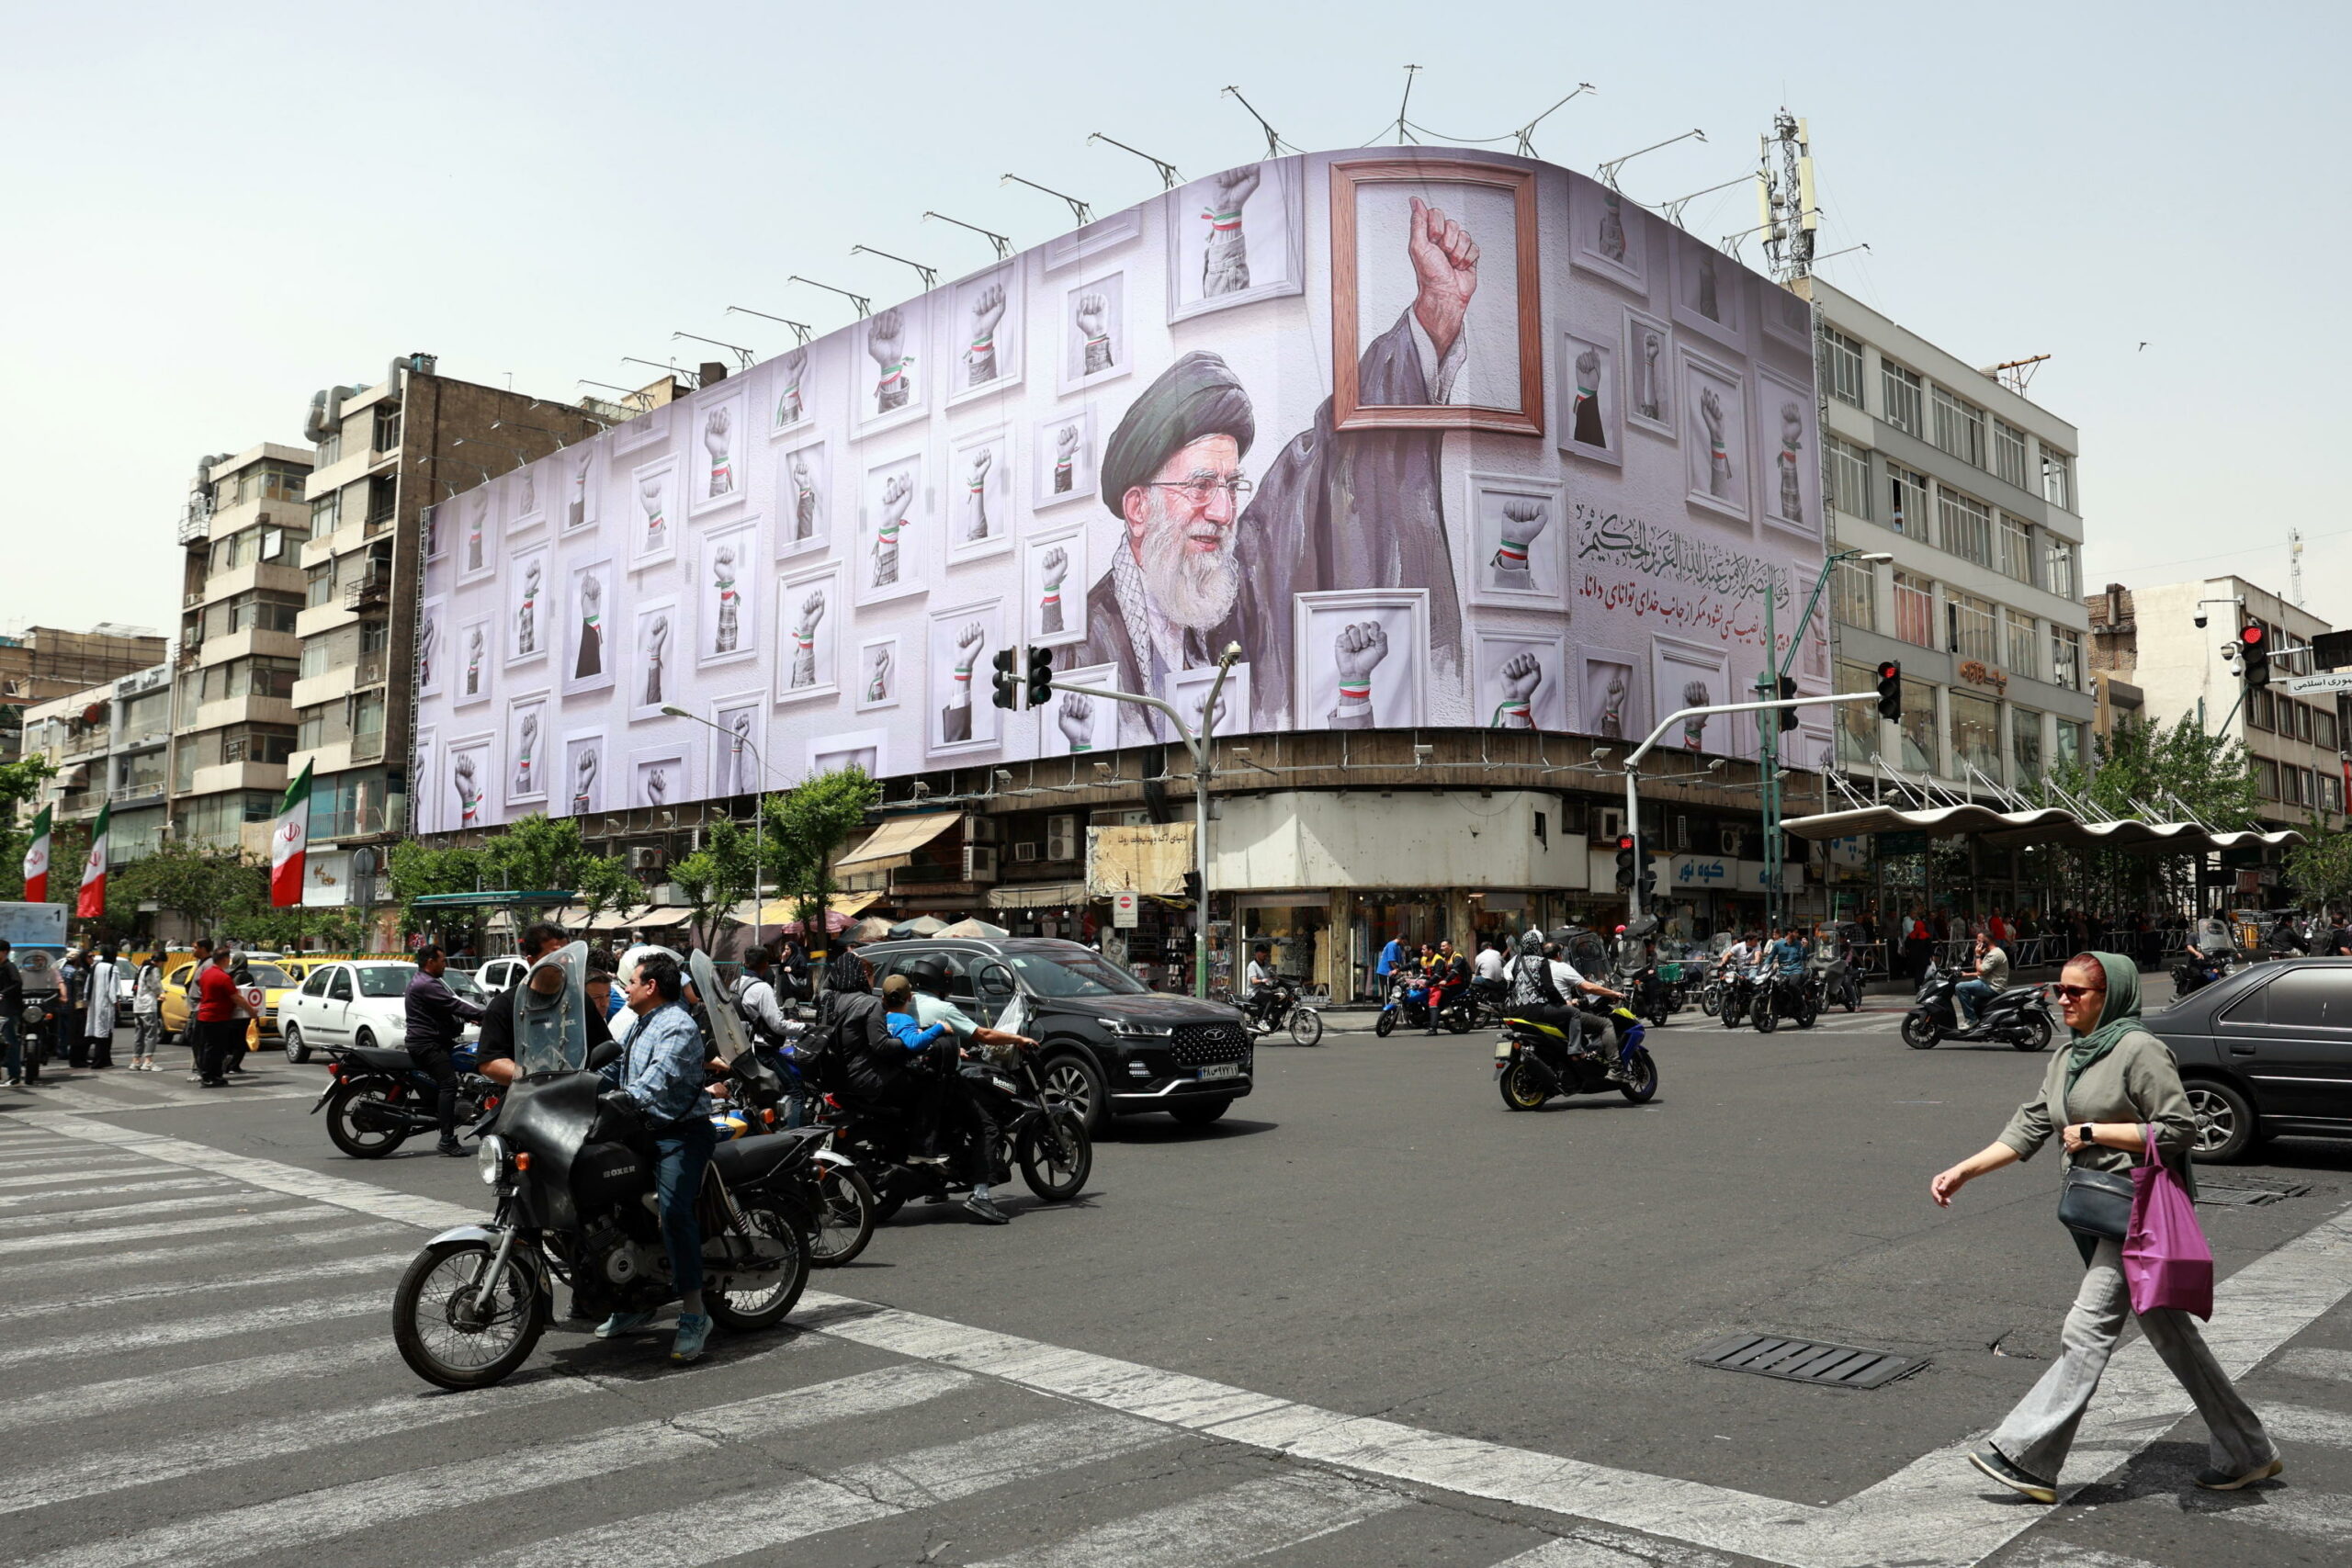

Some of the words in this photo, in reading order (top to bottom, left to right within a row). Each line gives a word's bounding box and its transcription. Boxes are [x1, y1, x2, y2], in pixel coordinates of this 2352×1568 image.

[1605, 581, 1635, 610] توانای
[1635, 588, 1658, 616] خدای
[1660, 595, 1684, 628] جانب
[1691, 594, 1708, 626] مگر
[1720, 602, 1742, 640] کسی
[1735, 615, 1758, 644] نصیب
[2294, 679, 2326, 691] اسلامی
[1679, 859, 1694, 883] نور
[1698, 860, 1724, 883] کوه
[993, 1076, 1016, 1092] Benelli
[603, 1166, 635, 1179] BOXER
